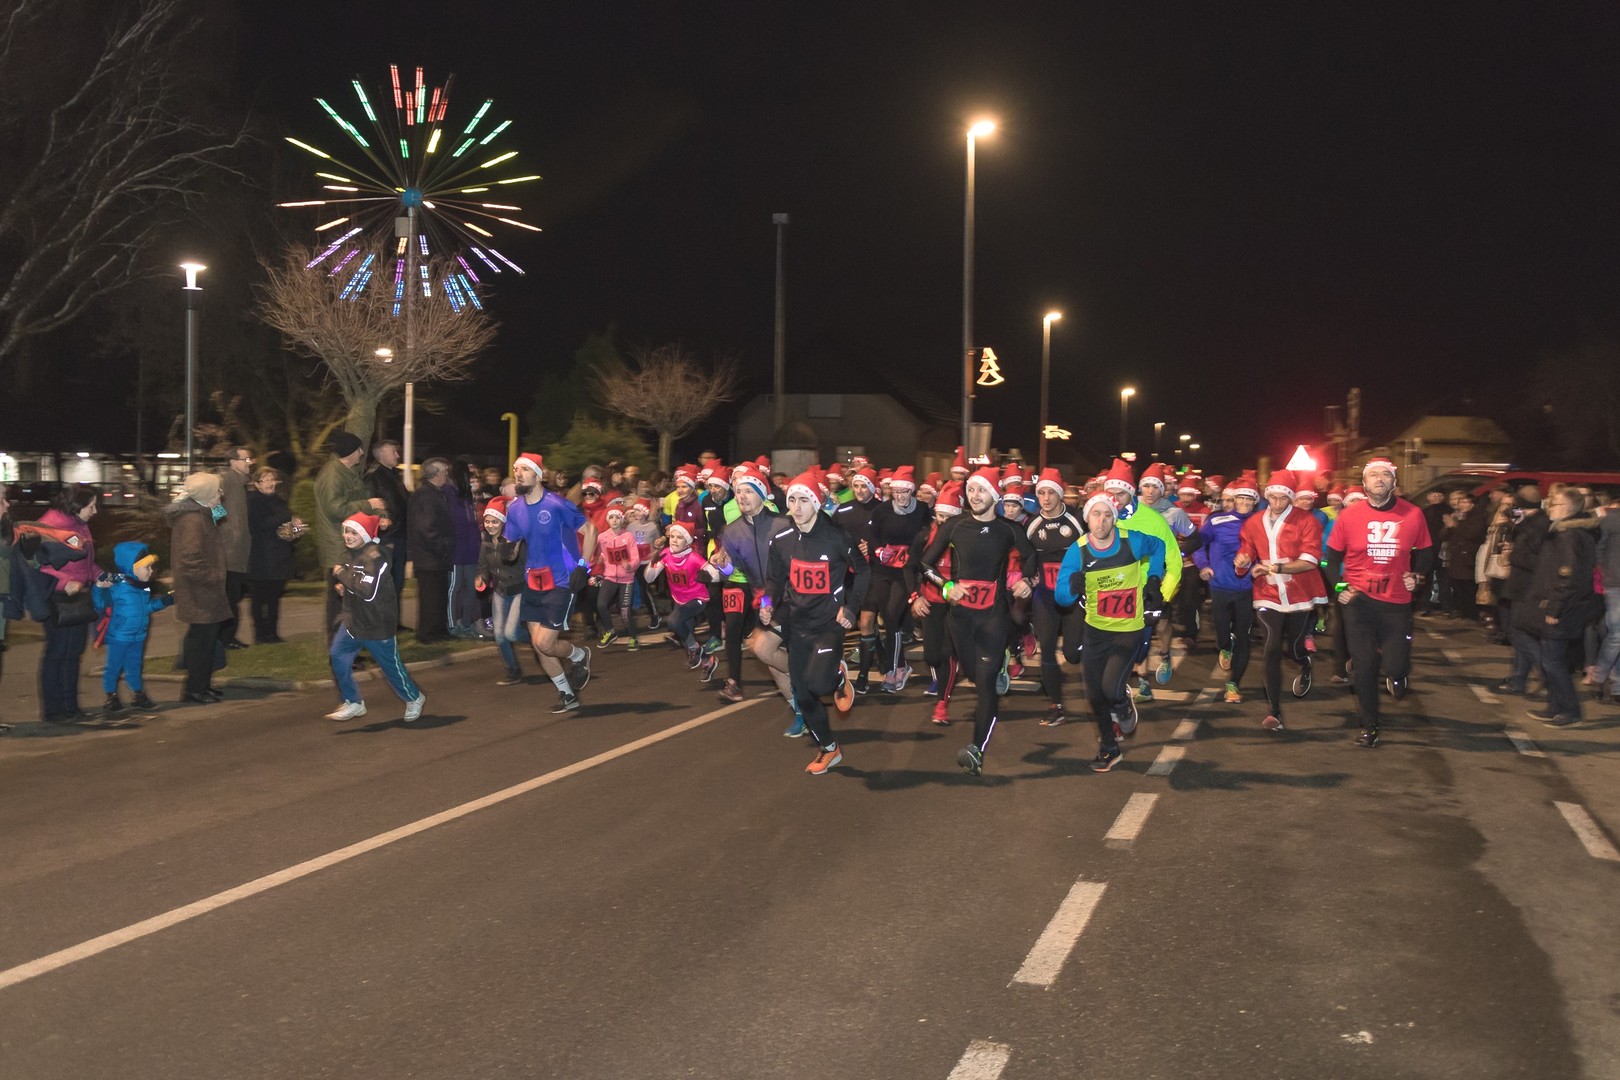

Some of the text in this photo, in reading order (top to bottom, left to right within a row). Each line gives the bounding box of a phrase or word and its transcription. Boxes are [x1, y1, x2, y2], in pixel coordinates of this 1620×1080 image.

[1367, 521, 1397, 543] 32
[794, 568, 826, 590] 163
[1101, 594, 1135, 615] 178
